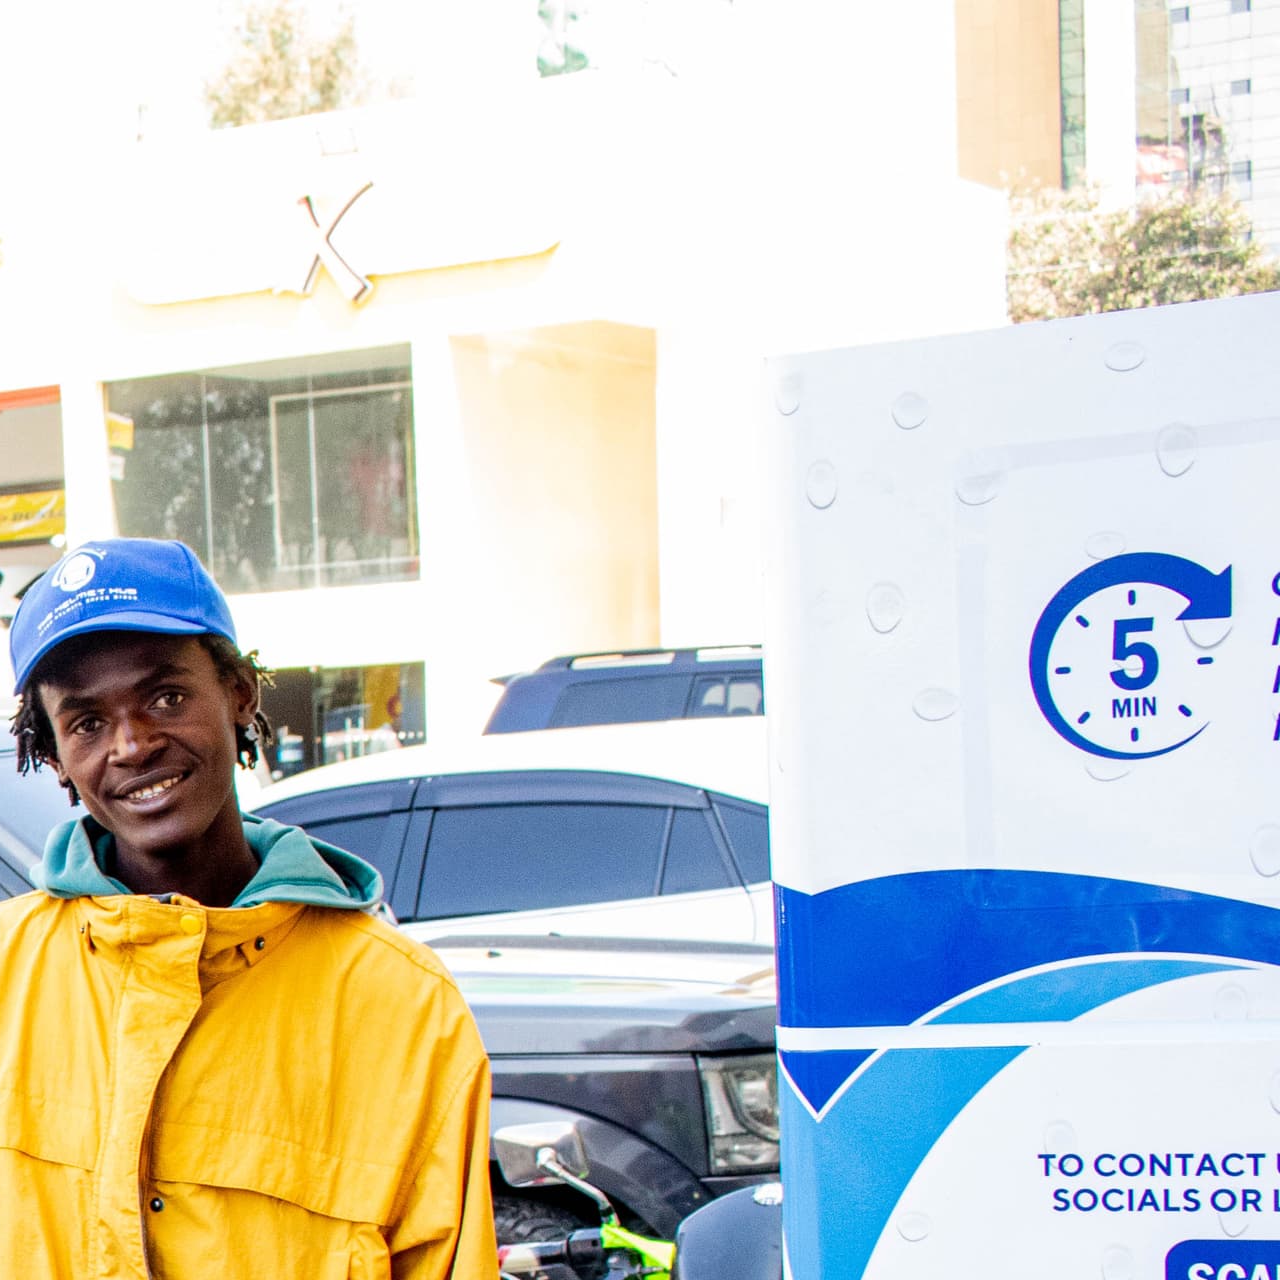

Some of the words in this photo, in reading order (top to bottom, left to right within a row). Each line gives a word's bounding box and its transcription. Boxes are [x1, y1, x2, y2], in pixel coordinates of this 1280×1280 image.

[1110, 616, 1160, 691] 5
[1112, 696, 1158, 719] MIN
[1037, 1153, 1085, 1178] TO
[1093, 1153, 1267, 1178] CONTACT
[1052, 1188, 1202, 1213] SOCIALS
[1209, 1188, 1264, 1213] OR
